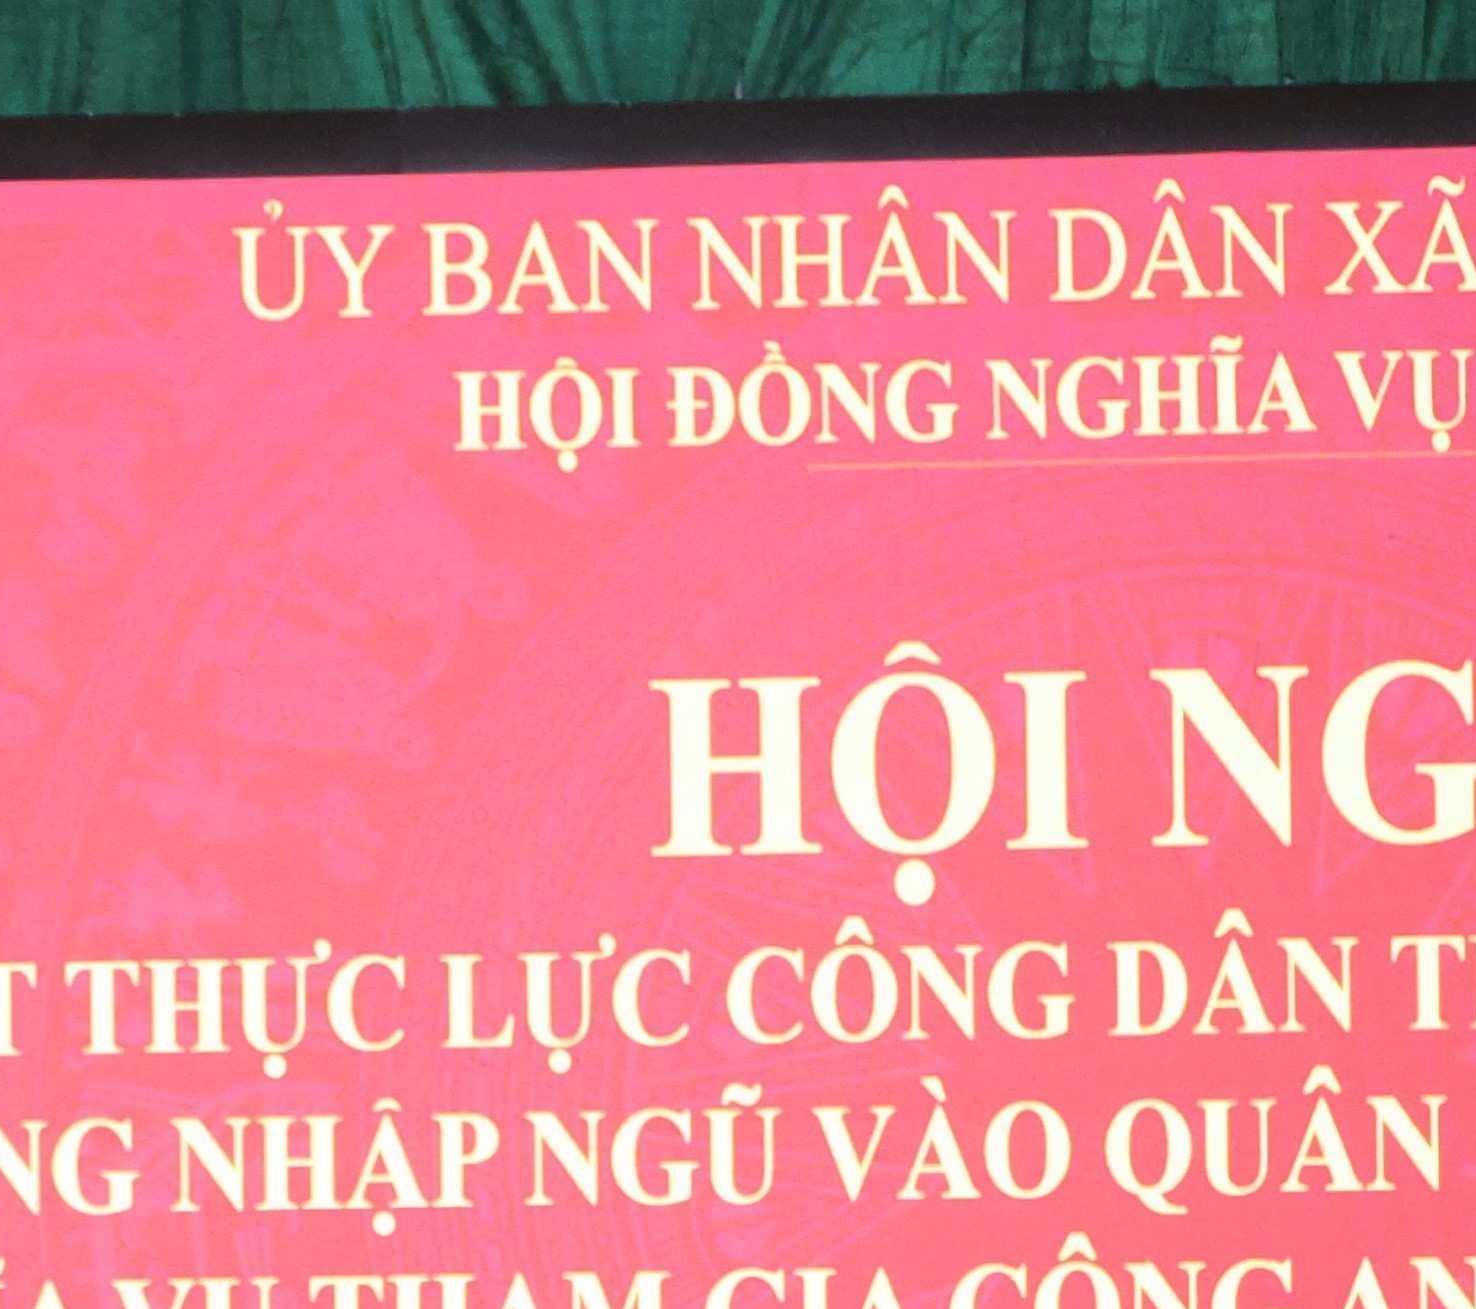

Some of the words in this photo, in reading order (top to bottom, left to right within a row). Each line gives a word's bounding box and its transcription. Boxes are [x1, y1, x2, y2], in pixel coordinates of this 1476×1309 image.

[234, 200, 394, 321] ỦY
[423, 219, 658, 315] BAN
[688, 185, 1015, 309] NHÂN
[1050, 179, 1292, 301] DÂN
[454, 358, 640, 472] HỘI
[667, 342, 958, 446] ĐỒNG
[986, 336, 1316, 439] NGHĨA
[1344, 349, 1472, 456] VỤ
[649, 642, 1088, 905] HỘI
[65, 939, 405, 1078] THỰC
[441, 934, 690, 1073] LỰC
[727, 916, 1074, 1044] CÔNG
[1108, 909, 1358, 1035] DÂN
[172, 1098, 499, 1236] NHẬP
[526, 1083, 780, 1205] NGŨ
[813, 1076, 1071, 1201] VÀO
[1105, 1065, 1445, 1214] QUÂN
